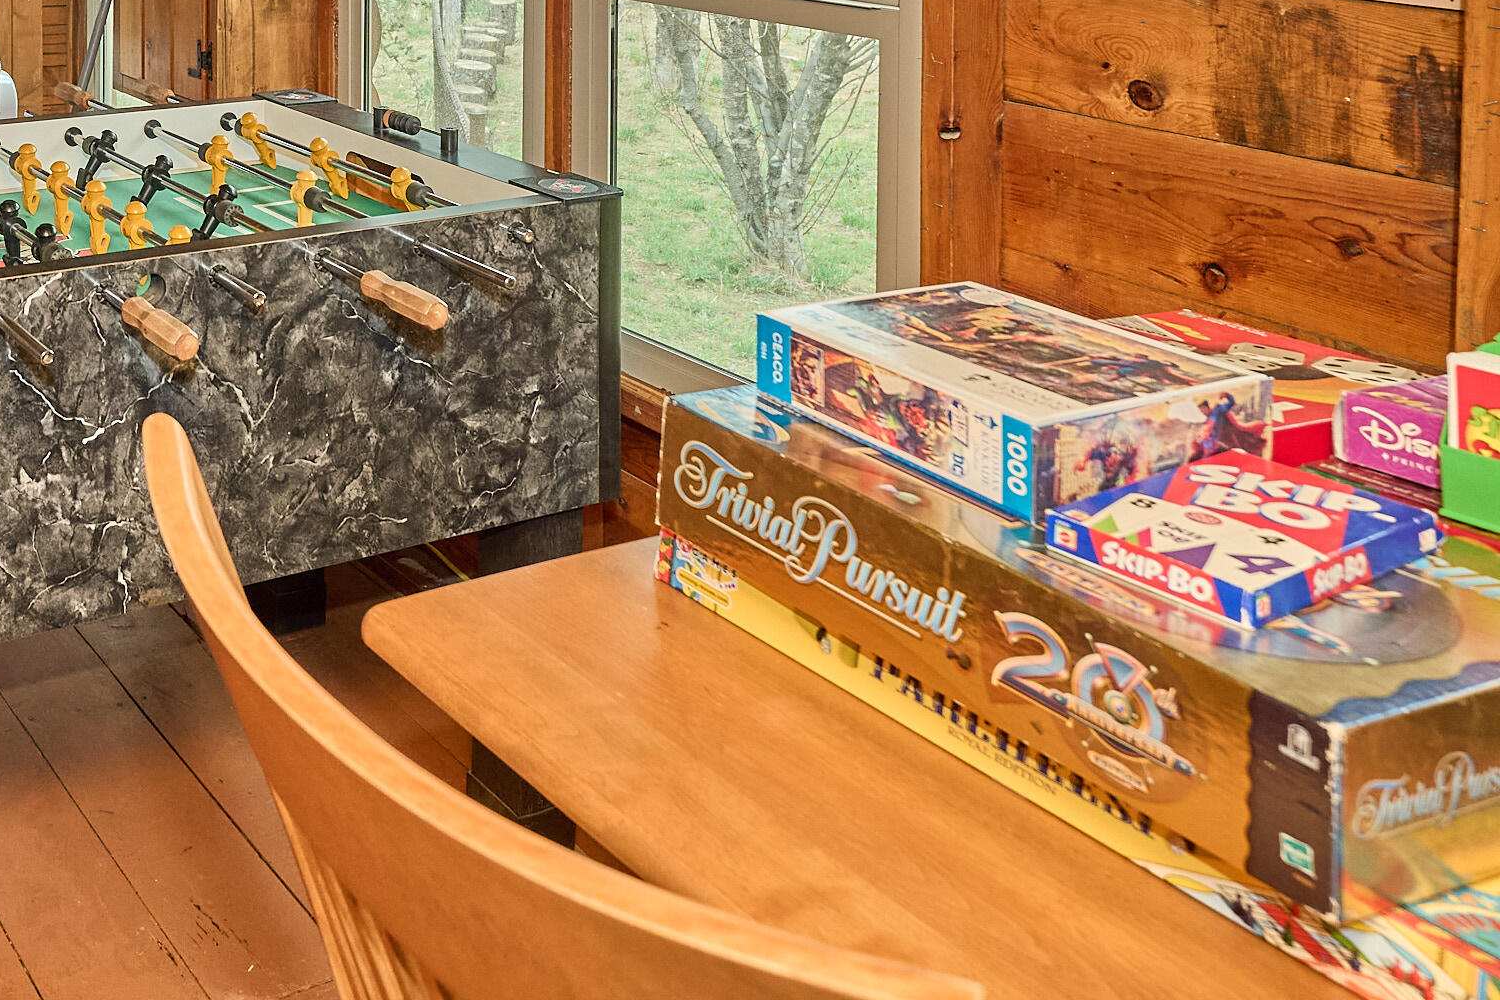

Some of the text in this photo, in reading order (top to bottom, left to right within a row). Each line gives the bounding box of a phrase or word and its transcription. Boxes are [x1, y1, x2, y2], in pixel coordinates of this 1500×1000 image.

[772, 332, 784, 383] CEACO
[952, 453, 965, 477] DC
[1006, 432, 1028, 497] 1000
[1192, 484, 1332, 530] BO
[673, 439, 968, 643] Trivial Pursuit
[1227, 553, 1296, 575] 4
[1101, 540, 1217, 604] SKIP-BO
[1313, 552, 1368, 598] SKIP-BO
[1352, 770, 1445, 840] Trivial
